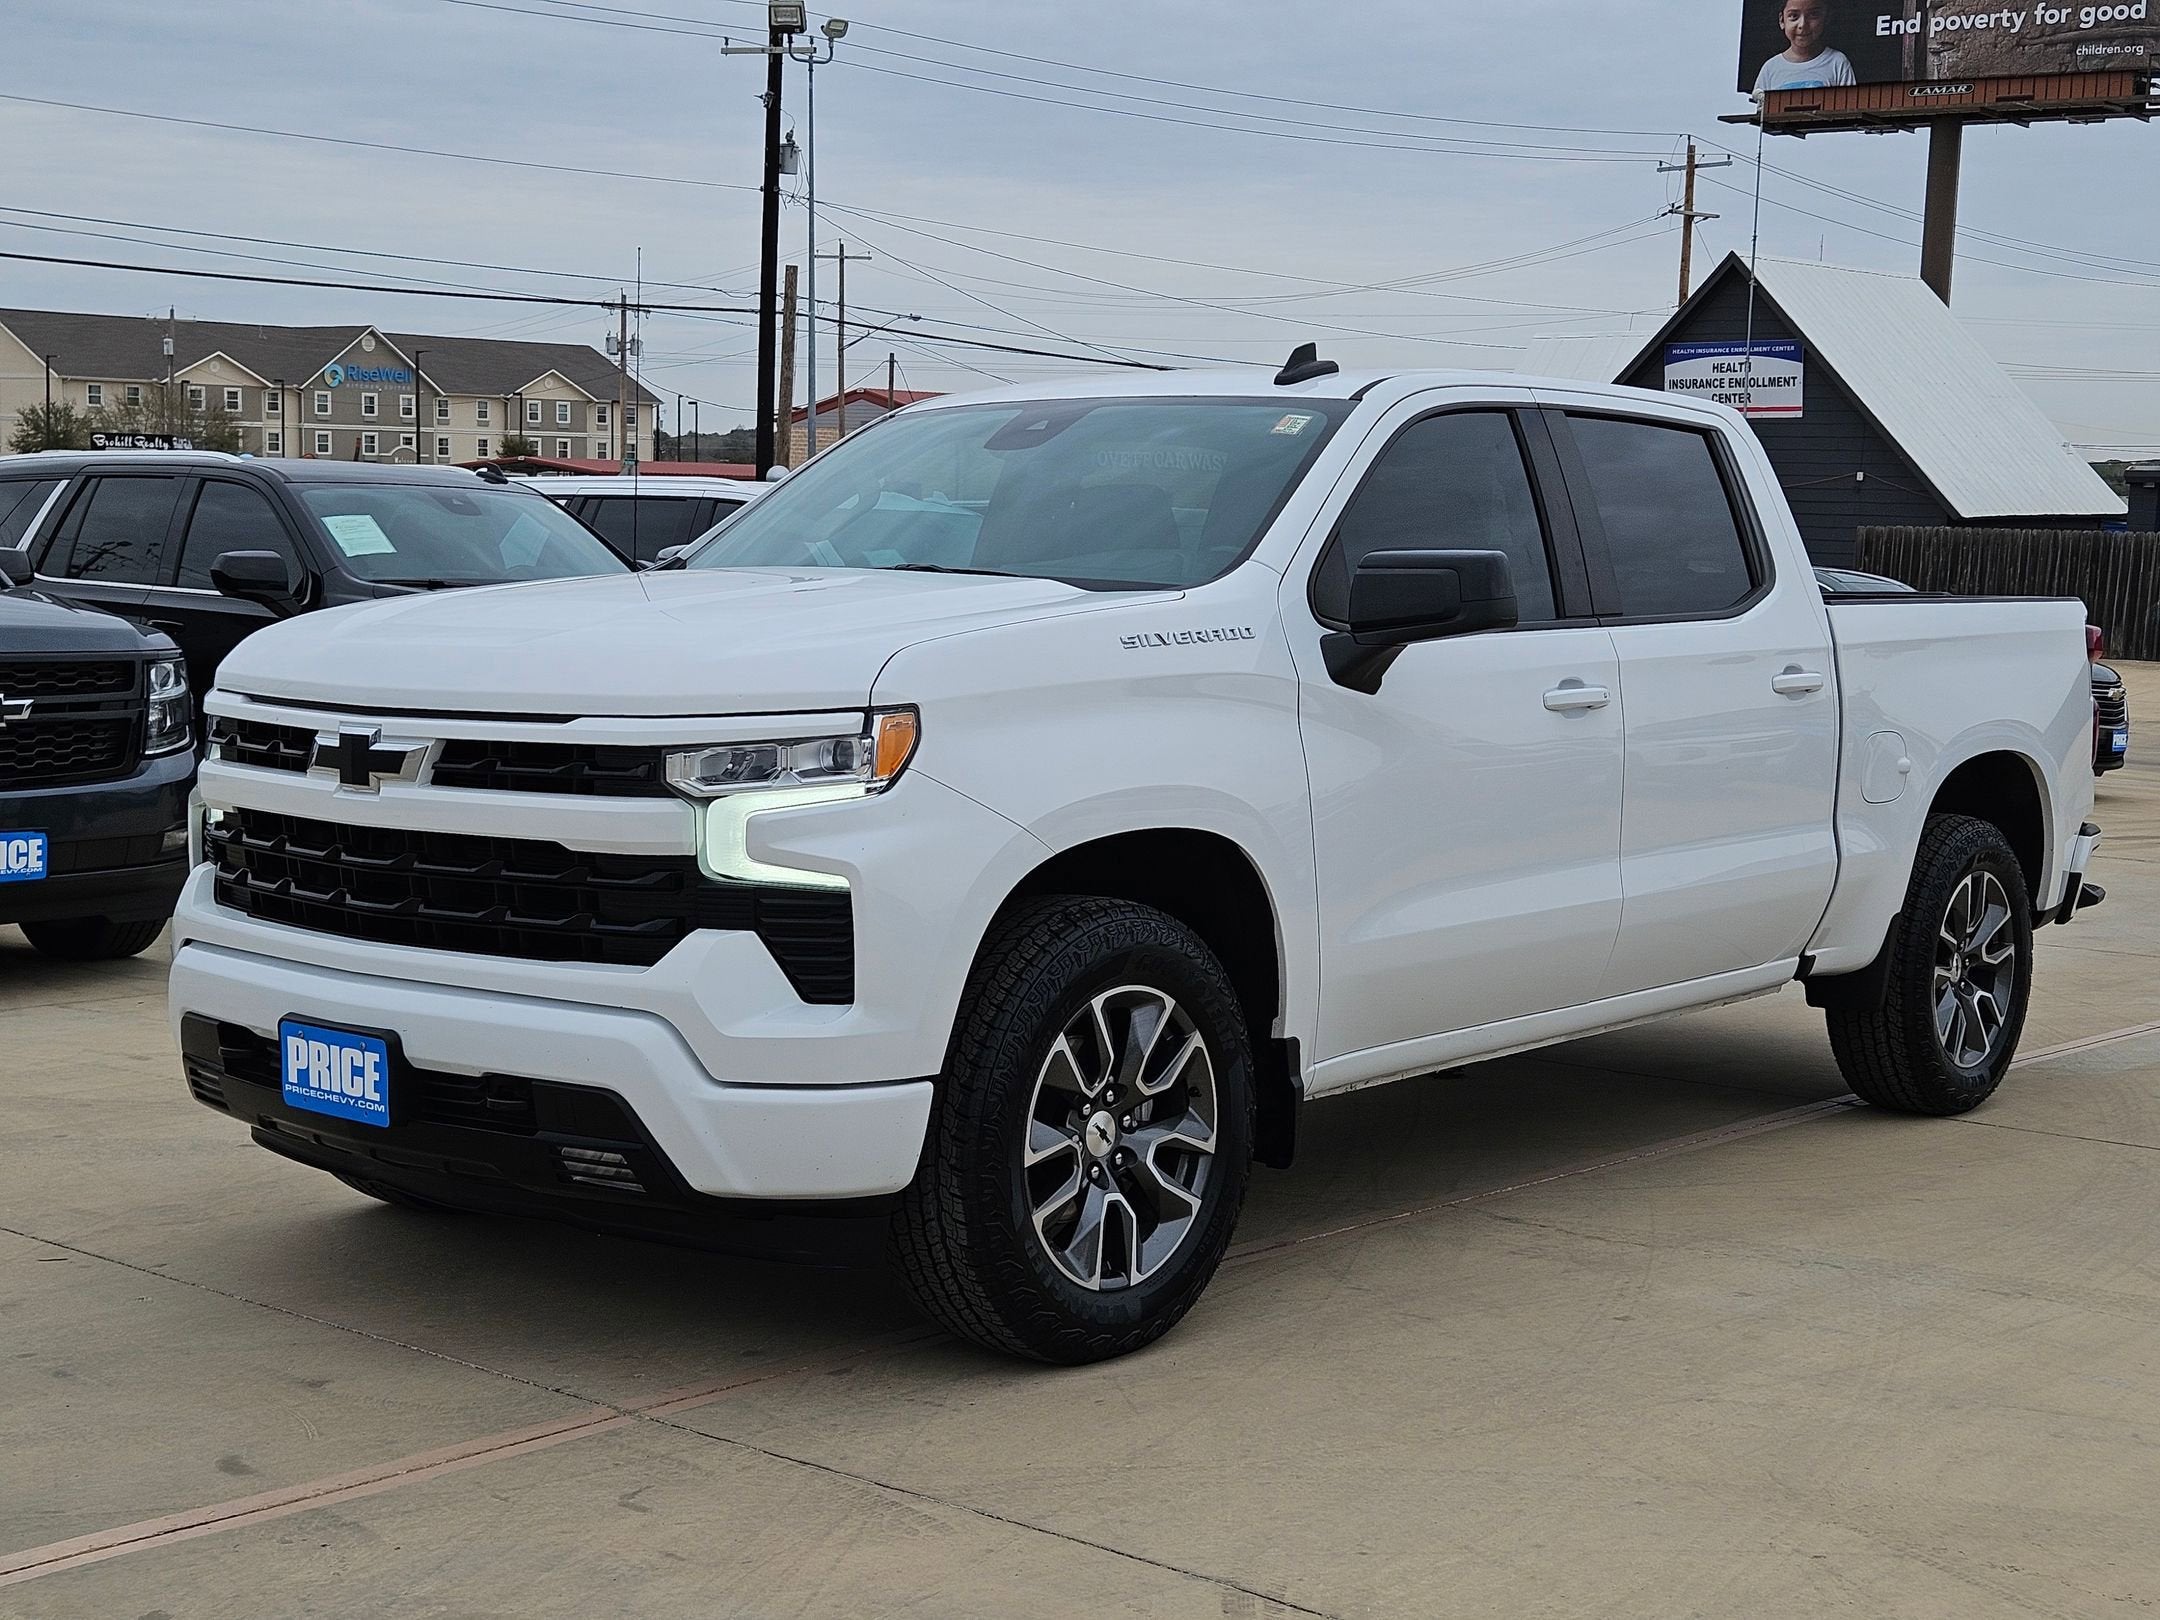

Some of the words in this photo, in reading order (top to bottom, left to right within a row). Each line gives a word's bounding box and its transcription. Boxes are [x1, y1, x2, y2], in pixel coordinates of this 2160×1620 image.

[1876, 11, 1921, 36] End
[1929, 8, 2026, 38] poverty
[2034, 2, 2071, 25] for
[2079, 0, 2147, 29] good
[2076, 44, 2144, 56] children.org
[1913, 84, 1968, 96] LAMAR
[347, 364, 412, 384] RiseWell
[1668, 377, 1725, 390] INSURANCE
[1120, 626, 1257, 650] SILVERADO
[286, 1035, 380, 1102] PRICE
[284, 1083, 386, 1113] PRICECHEVY.COM
